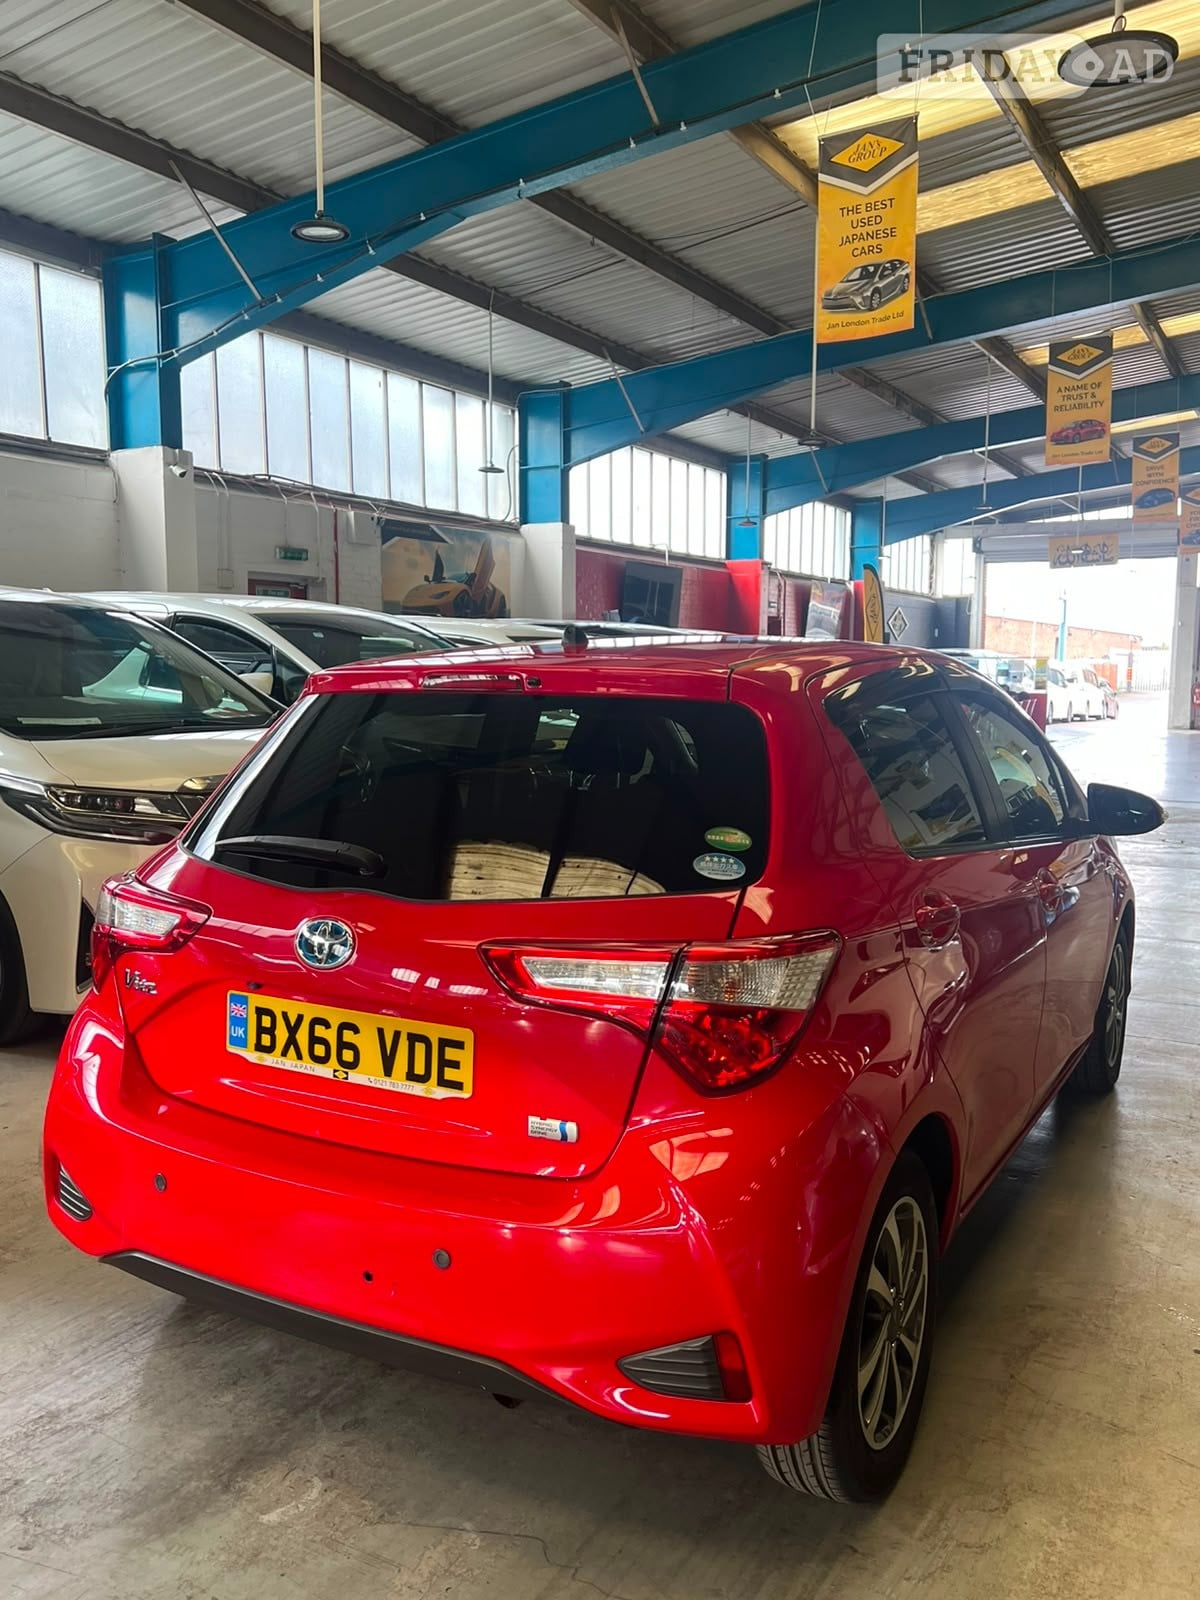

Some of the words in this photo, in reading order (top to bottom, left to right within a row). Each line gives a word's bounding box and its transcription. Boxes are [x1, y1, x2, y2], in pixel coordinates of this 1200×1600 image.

[848, 147, 887, 163] GROUP
[839, 203, 862, 218] THE
[865, 198, 896, 214] BEST
[850, 215, 883, 230] USED
[839, 227, 897, 247] JAPANESE
[851, 243, 883, 258] CARS
[826, 322, 840, 330] Jan
[841, 319, 870, 328] London
[871, 315, 891, 324] Trade
[892, 311, 905, 319] Ltd
[1056, 386, 1063, 394] A
[1064, 383, 1089, 393] NAME
[1090, 381, 1102, 390] OF
[1061, 392, 1089, 402] TRUST
[1090, 391, 1097, 399] &
[1053, 400, 1105, 412] RELIABILITY
[1135, 477, 1175, 486] CONFIDENCE
[231, 1025, 245, 1039] UK
[253, 1006, 361, 1070] BX66
[376, 1027, 466, 1092] VDE
[271, 1058, 286, 1068] JAN
[290, 1062, 316, 1073] JAPAN
